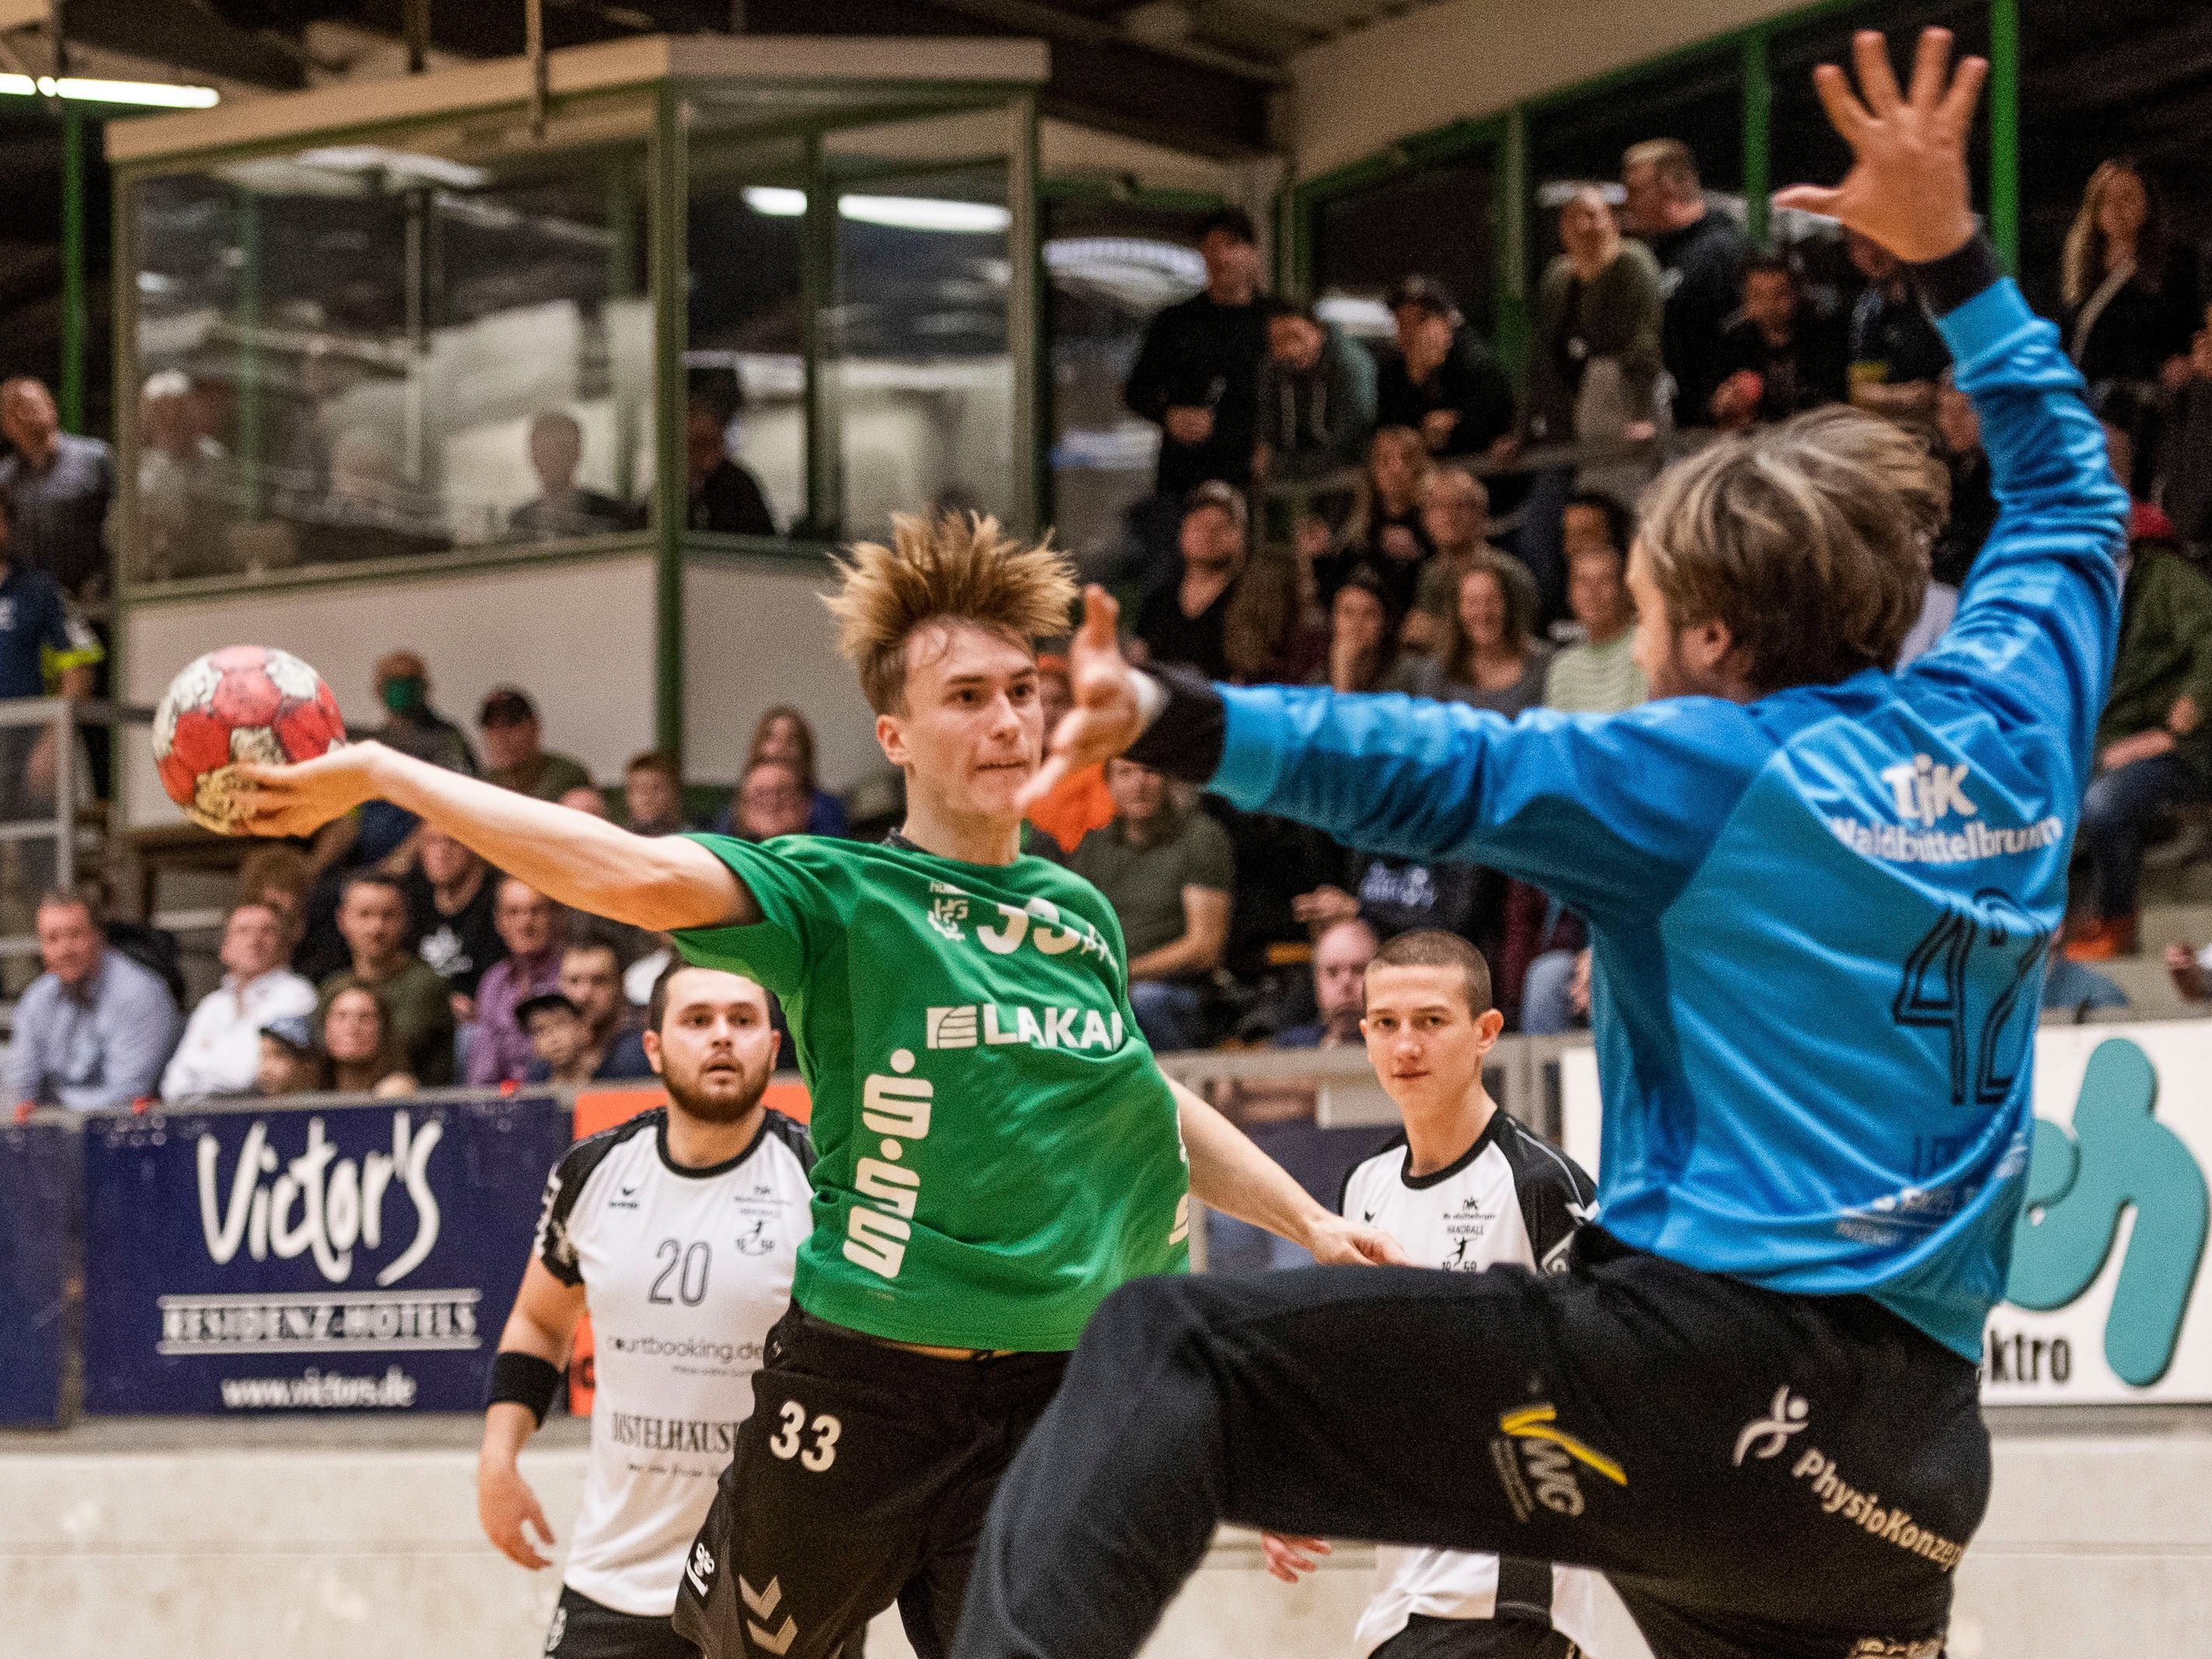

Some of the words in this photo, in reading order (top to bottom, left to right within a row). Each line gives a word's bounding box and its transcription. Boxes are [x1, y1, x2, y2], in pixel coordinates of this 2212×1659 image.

[1893, 887, 2048, 1105] 42
[197, 1109, 443, 1286] Victor's
[648, 1238, 712, 1307] 20
[1989, 1327, 2072, 1385] ktro
[770, 1401, 843, 1472] 33
